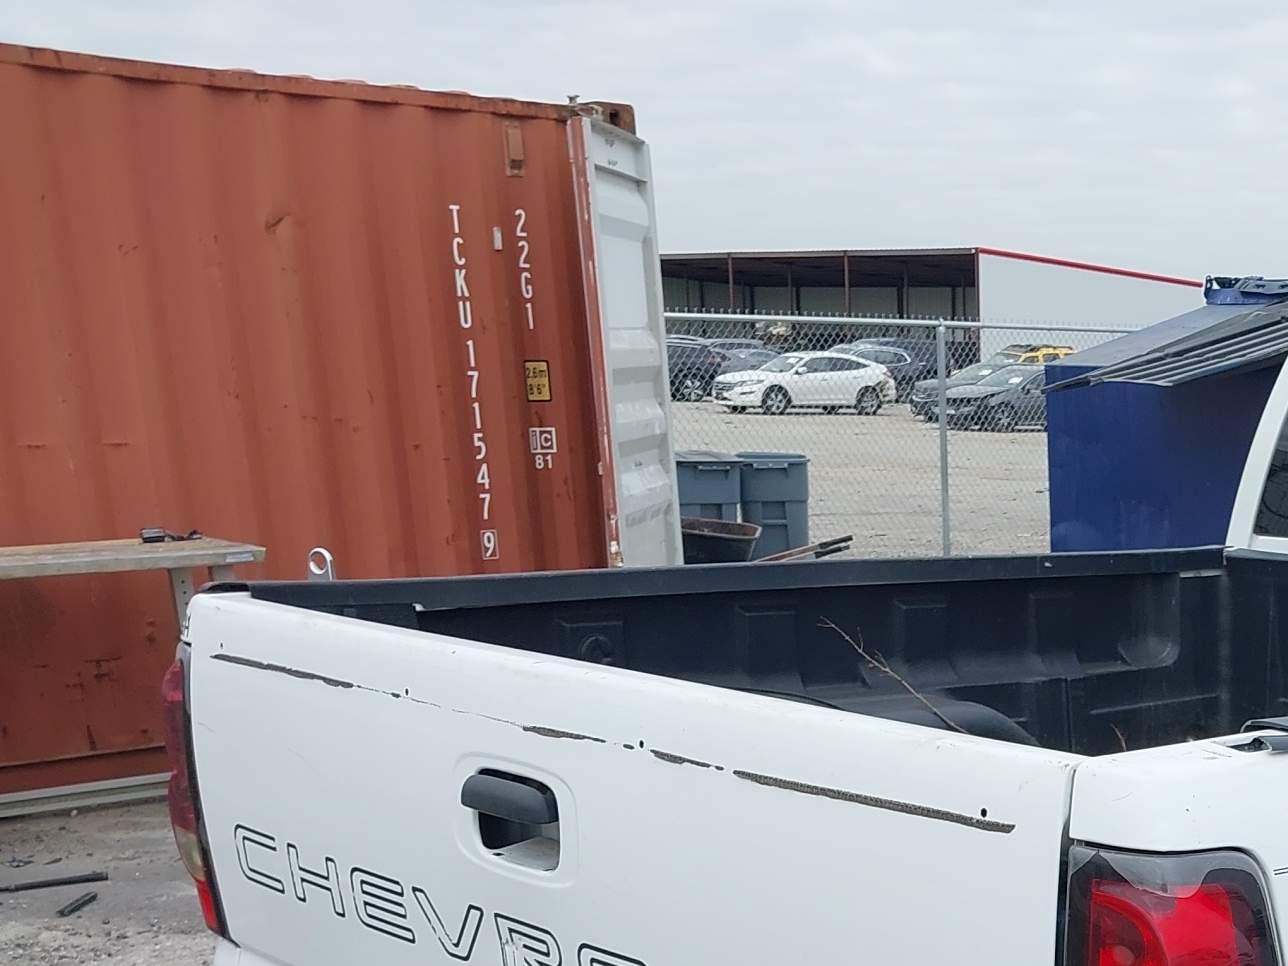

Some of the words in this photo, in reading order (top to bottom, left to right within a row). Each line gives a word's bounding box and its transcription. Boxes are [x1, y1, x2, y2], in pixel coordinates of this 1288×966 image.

[448, 204, 473, 329] TCKU
[514, 208, 535, 330] 22G1
[535, 454, 553, 469] 81
